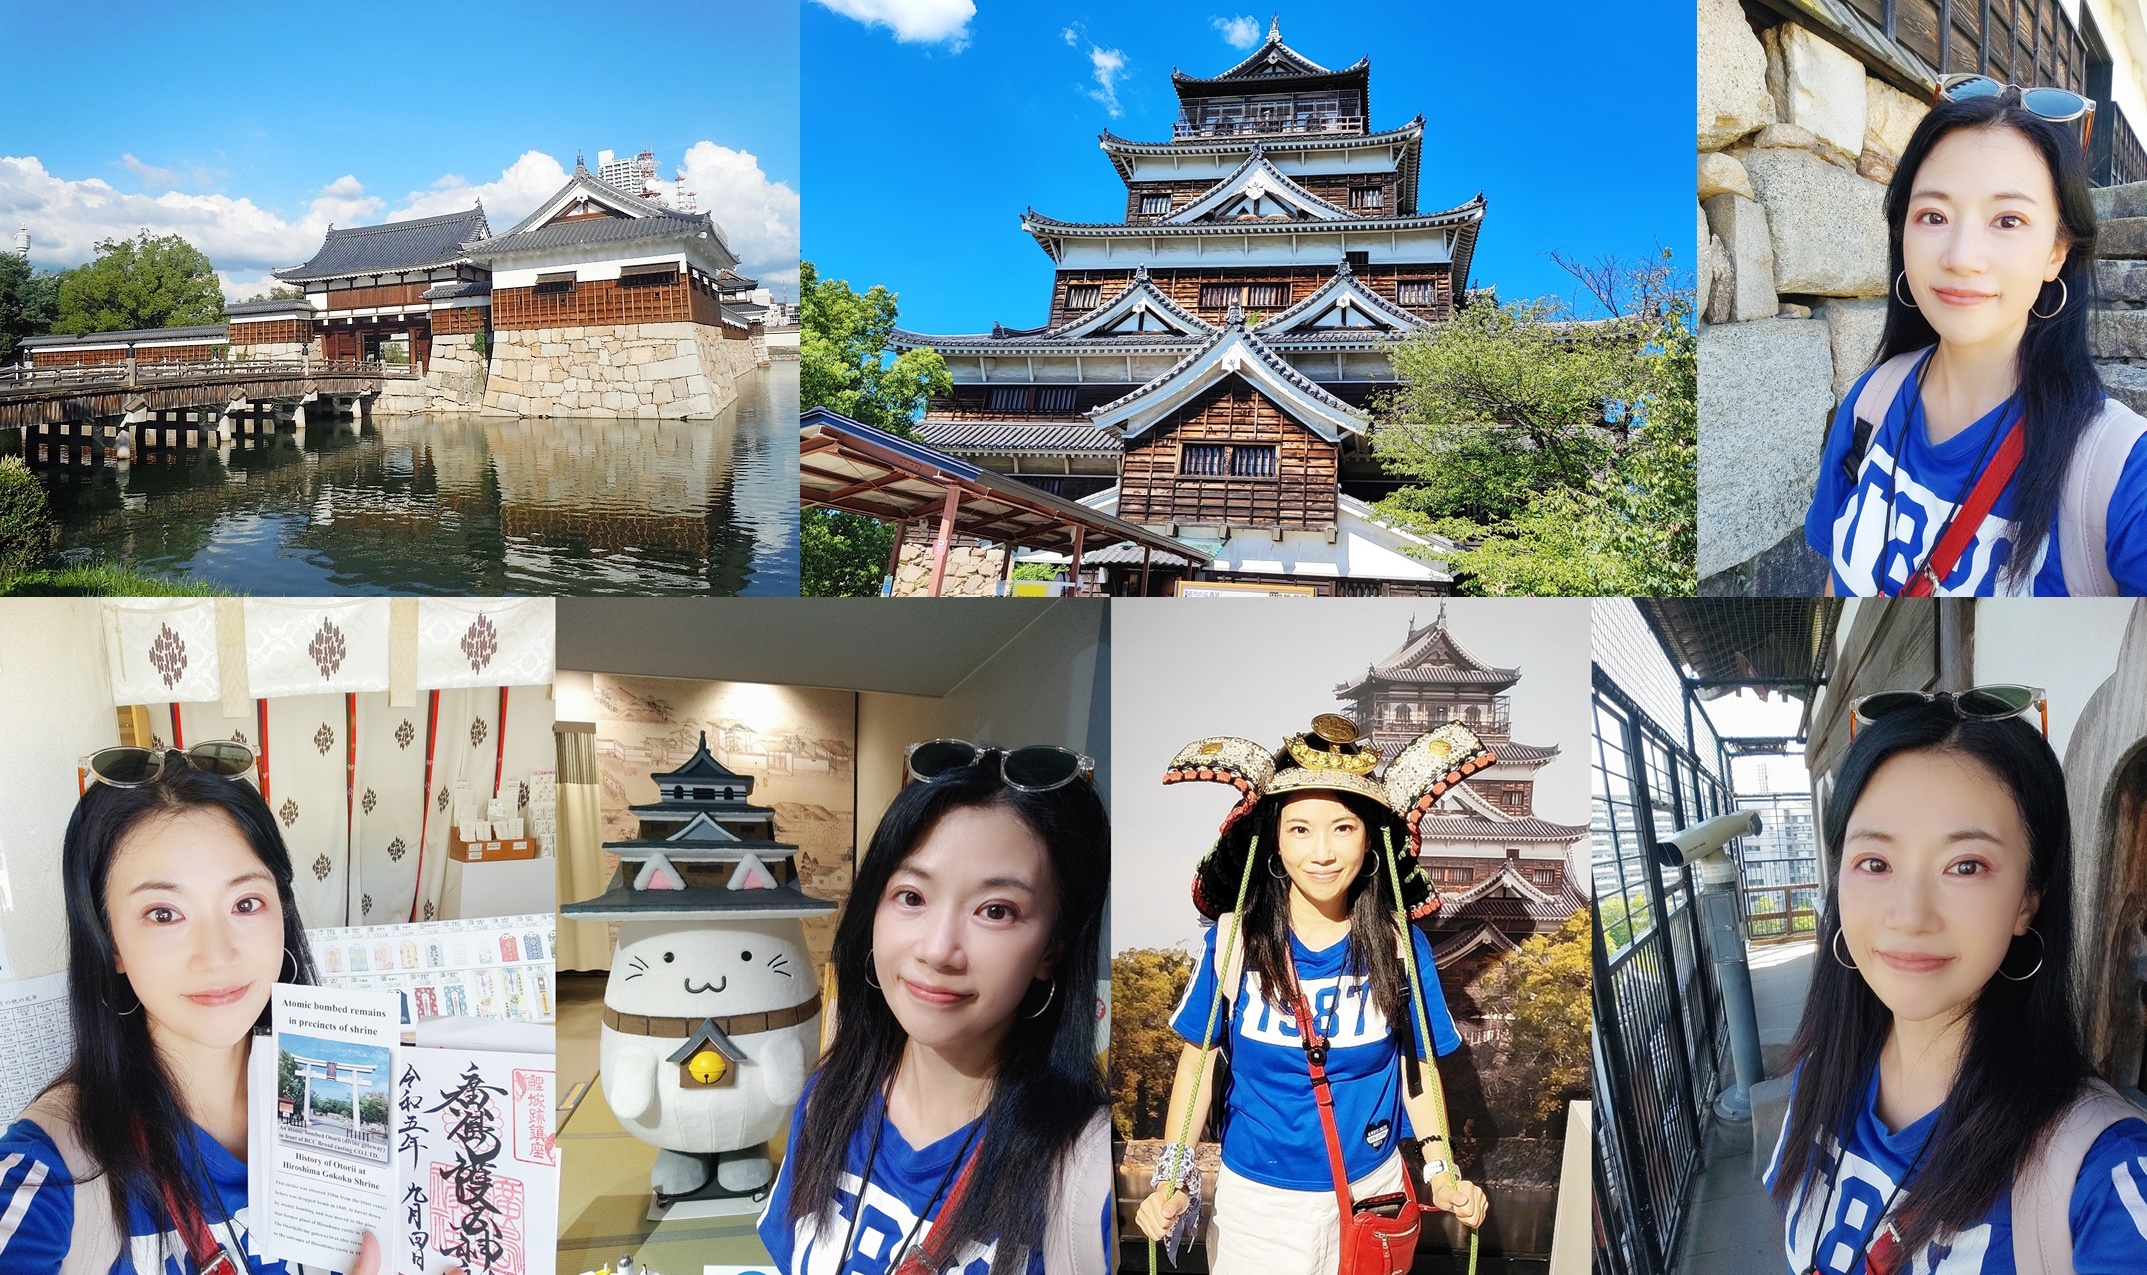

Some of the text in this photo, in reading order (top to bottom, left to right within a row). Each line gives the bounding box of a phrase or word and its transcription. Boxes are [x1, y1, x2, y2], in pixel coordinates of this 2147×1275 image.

[282, 999, 386, 1018] Atomic bombed remains
[289, 1016, 378, 1036] in precincts of shrine
[398, 1062, 429, 1173] 令和五年
[295, 1153, 322, 1166] History
[334, 1162, 356, 1172] Otorii
[283, 1161, 380, 1190] Hiroshima Gokoku Shrine
[295, 1205, 314, 1214] bombing
[298, 1196, 316, 1204] dropped
[317, 1221, 340, 1231] Hiroshima
[400, 1182, 429, 1272] 九月四日
[286, 1234, 304, 1243] entrance
[311, 1240, 334, 1250] Hiroshima
